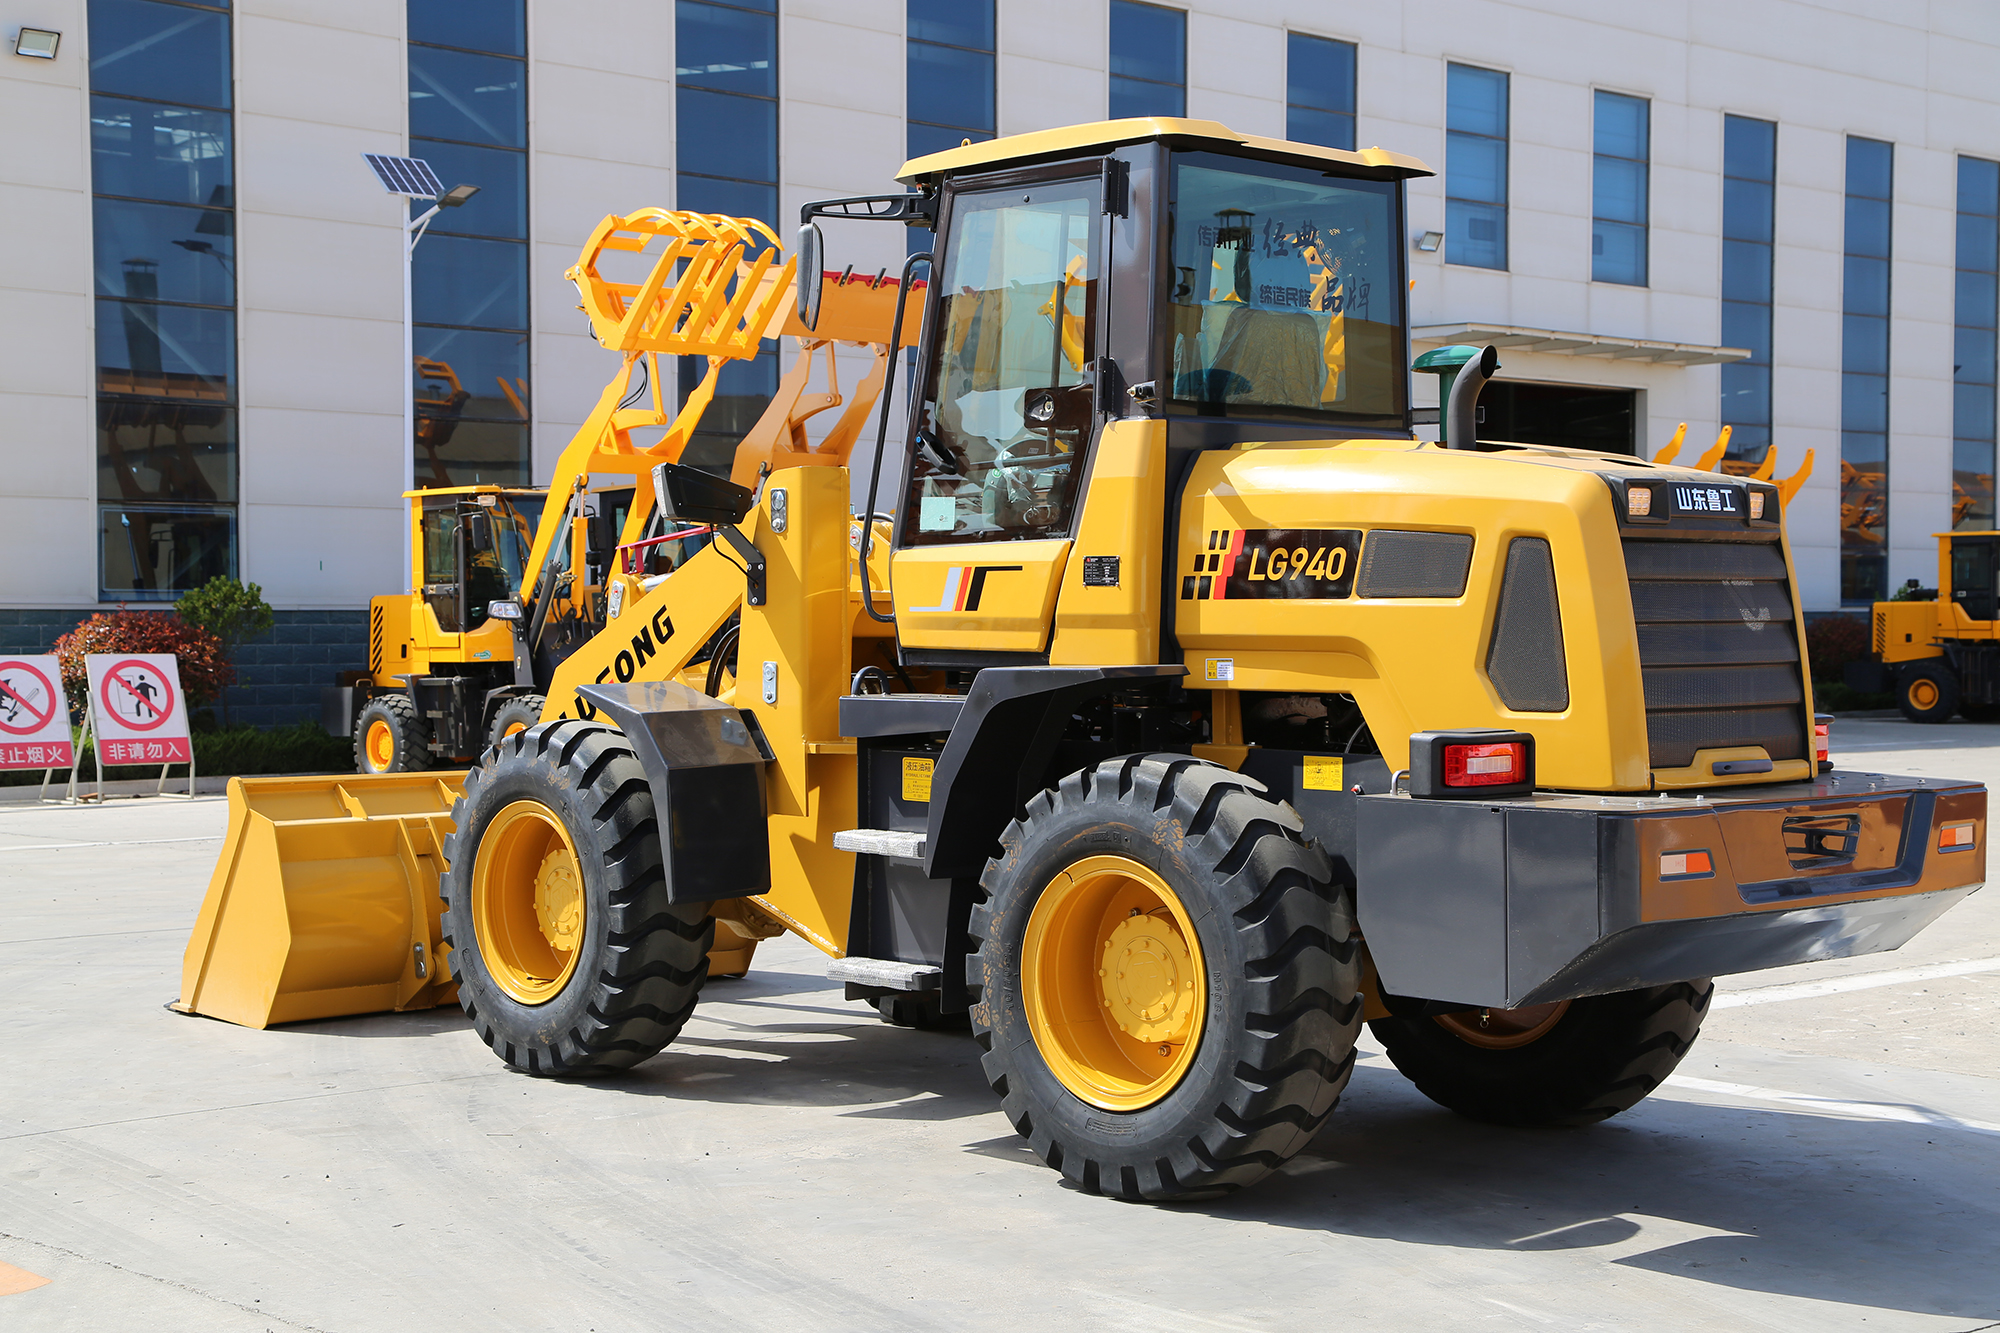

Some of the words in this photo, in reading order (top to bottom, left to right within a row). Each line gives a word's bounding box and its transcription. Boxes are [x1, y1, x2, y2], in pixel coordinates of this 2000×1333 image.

[1675, 487, 1736, 512] 山东鲁工
[1247, 547, 1348, 581] LG940
[559, 604, 675, 721] UONG
[108, 742, 183, 761] 非请勿入
